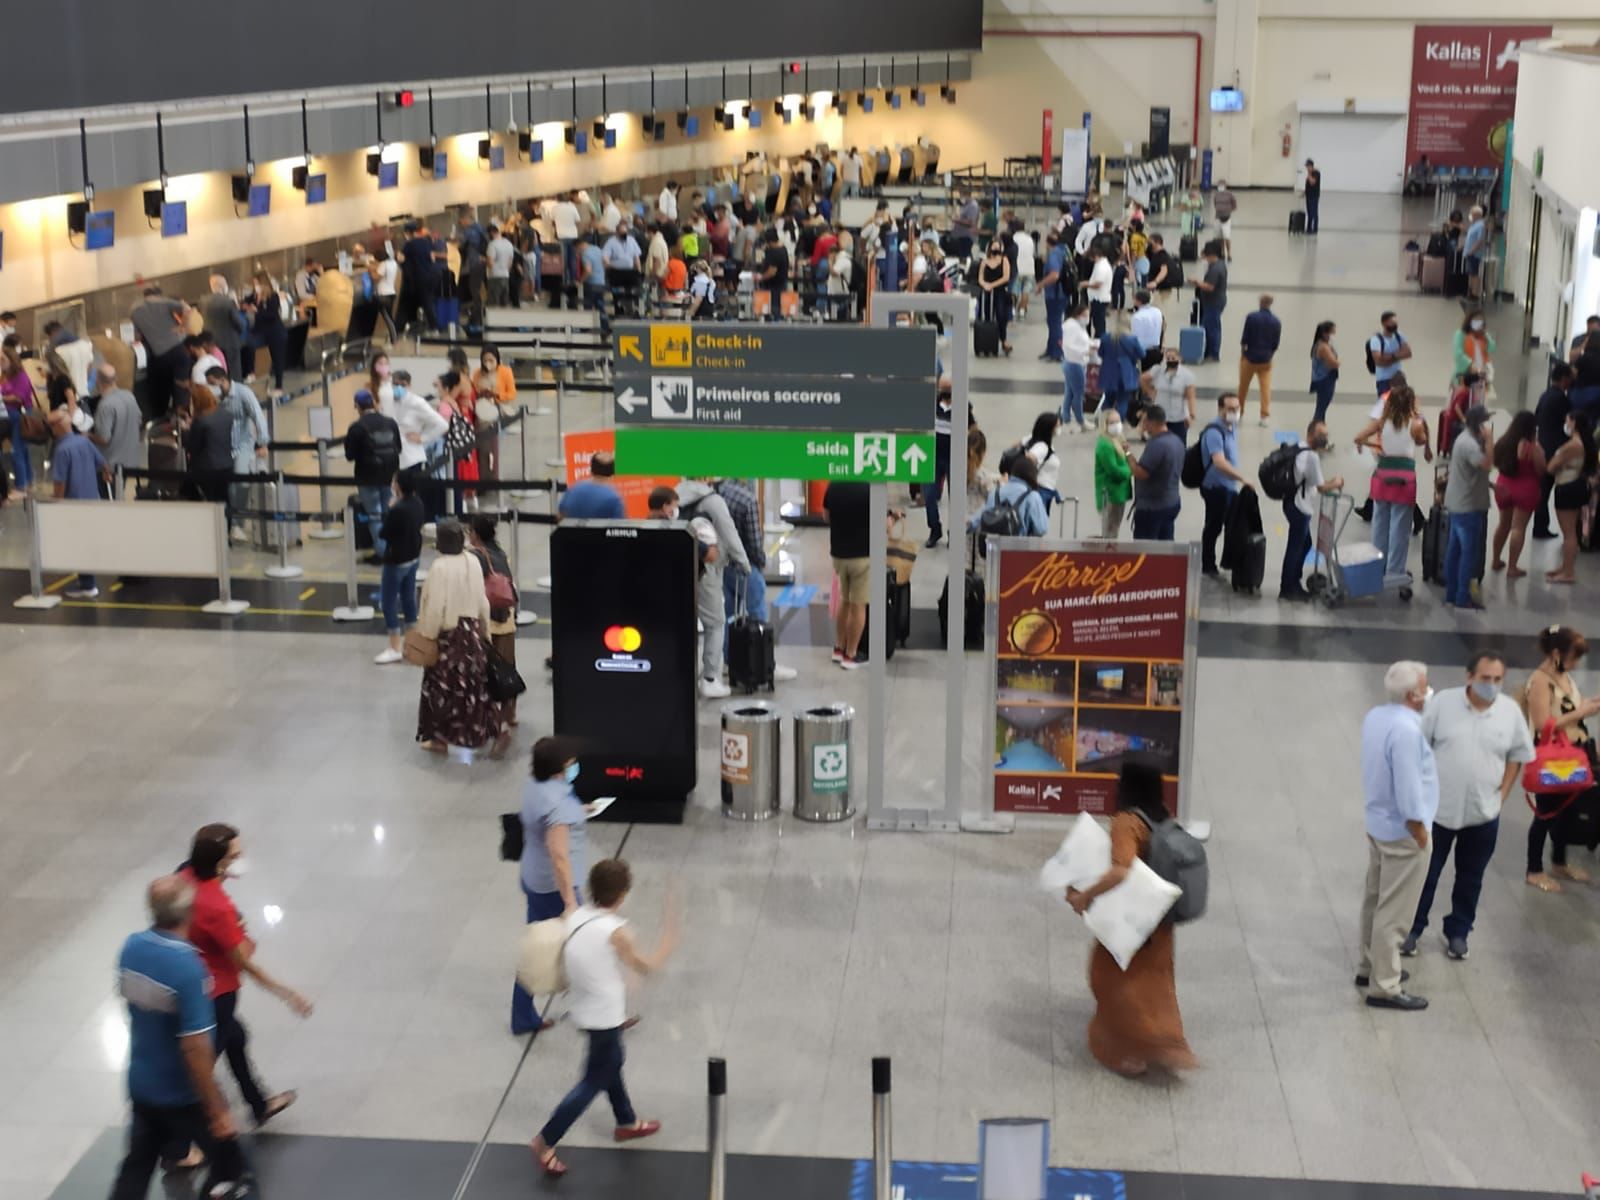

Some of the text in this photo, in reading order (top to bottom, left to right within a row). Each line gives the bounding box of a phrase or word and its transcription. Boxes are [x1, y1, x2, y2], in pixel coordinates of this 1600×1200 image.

[1426, 41, 1481, 60] Kallas
[1418, 84, 1440, 94] Você
[1473, 85, 1501, 94] Kallas
[695, 334, 763, 350] Check-in
[695, 355, 746, 368] Check-in
[696, 386, 841, 404] Primeiros socorros
[696, 407, 742, 421] First aid
[806, 441, 849, 456] Saída
[828, 462, 849, 475] Exit
[605, 528, 638, 538] AIRHUB
[1044, 587, 1180, 610] SUA MARCA NOS AEROPORTOS
[1008, 784, 1036, 796] Kallas
